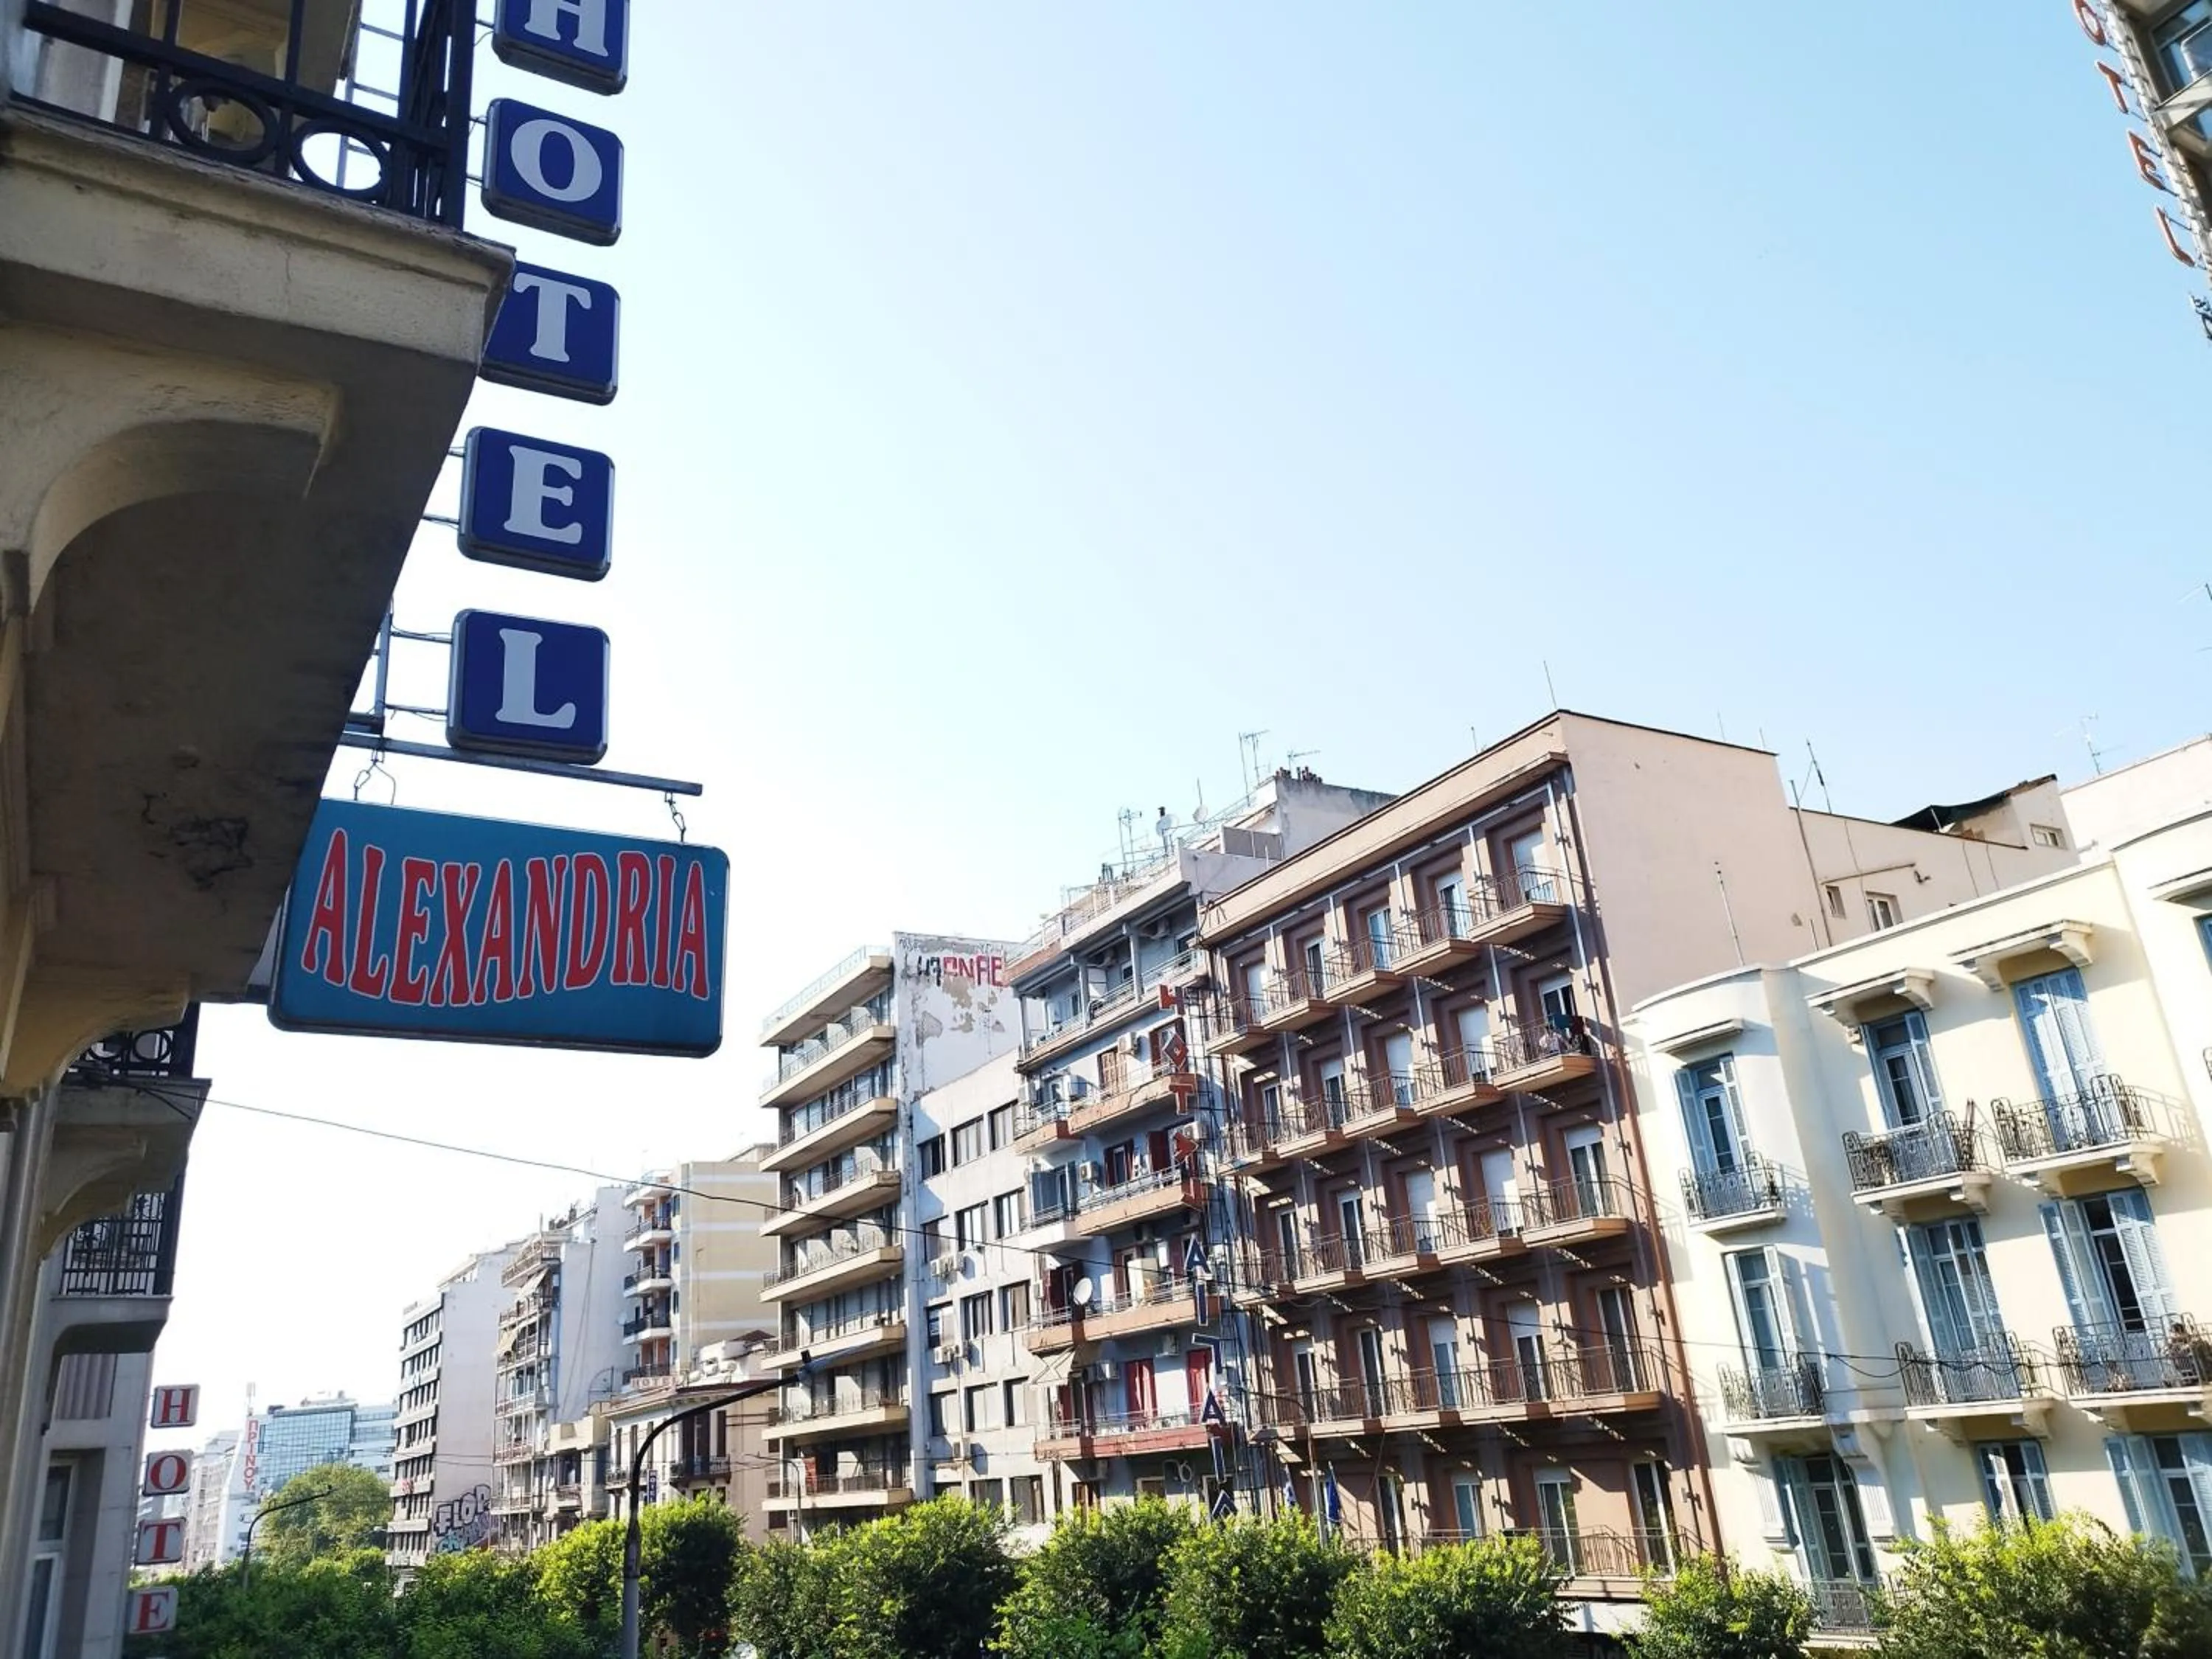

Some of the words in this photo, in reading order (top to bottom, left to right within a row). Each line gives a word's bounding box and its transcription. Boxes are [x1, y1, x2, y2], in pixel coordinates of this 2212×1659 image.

[495, 0, 609, 728] HOTEL
[301, 827, 710, 1007] ALEXANDRIA
[135, 1388, 192, 1632] HOTE
